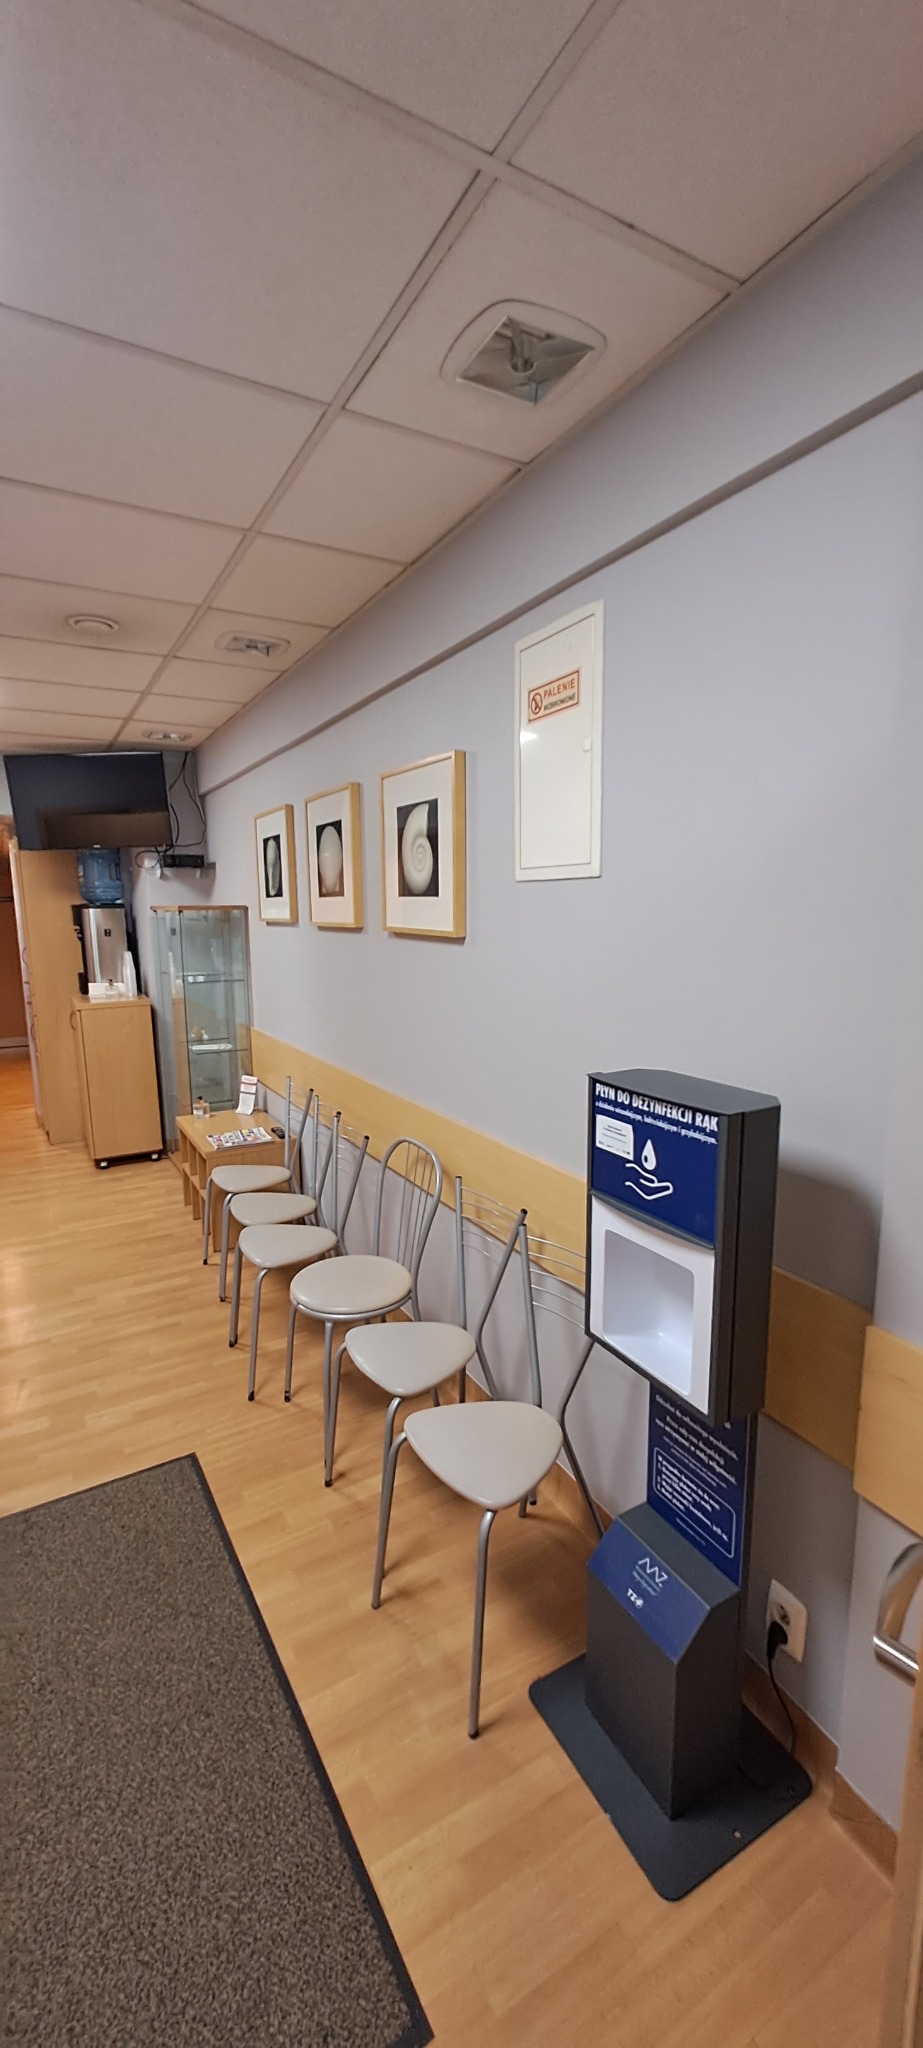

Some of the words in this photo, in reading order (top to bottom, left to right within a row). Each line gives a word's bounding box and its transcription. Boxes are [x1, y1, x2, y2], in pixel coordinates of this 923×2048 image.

[543, 678, 576, 699] PALENIE
[595, 1082, 616, 1101] PŁYN
[617, 1090, 630, 1105] DO
[632, 1094, 693, 1124] DEZYNFEKCJI
[695, 1112, 719, 1133] RĄK
